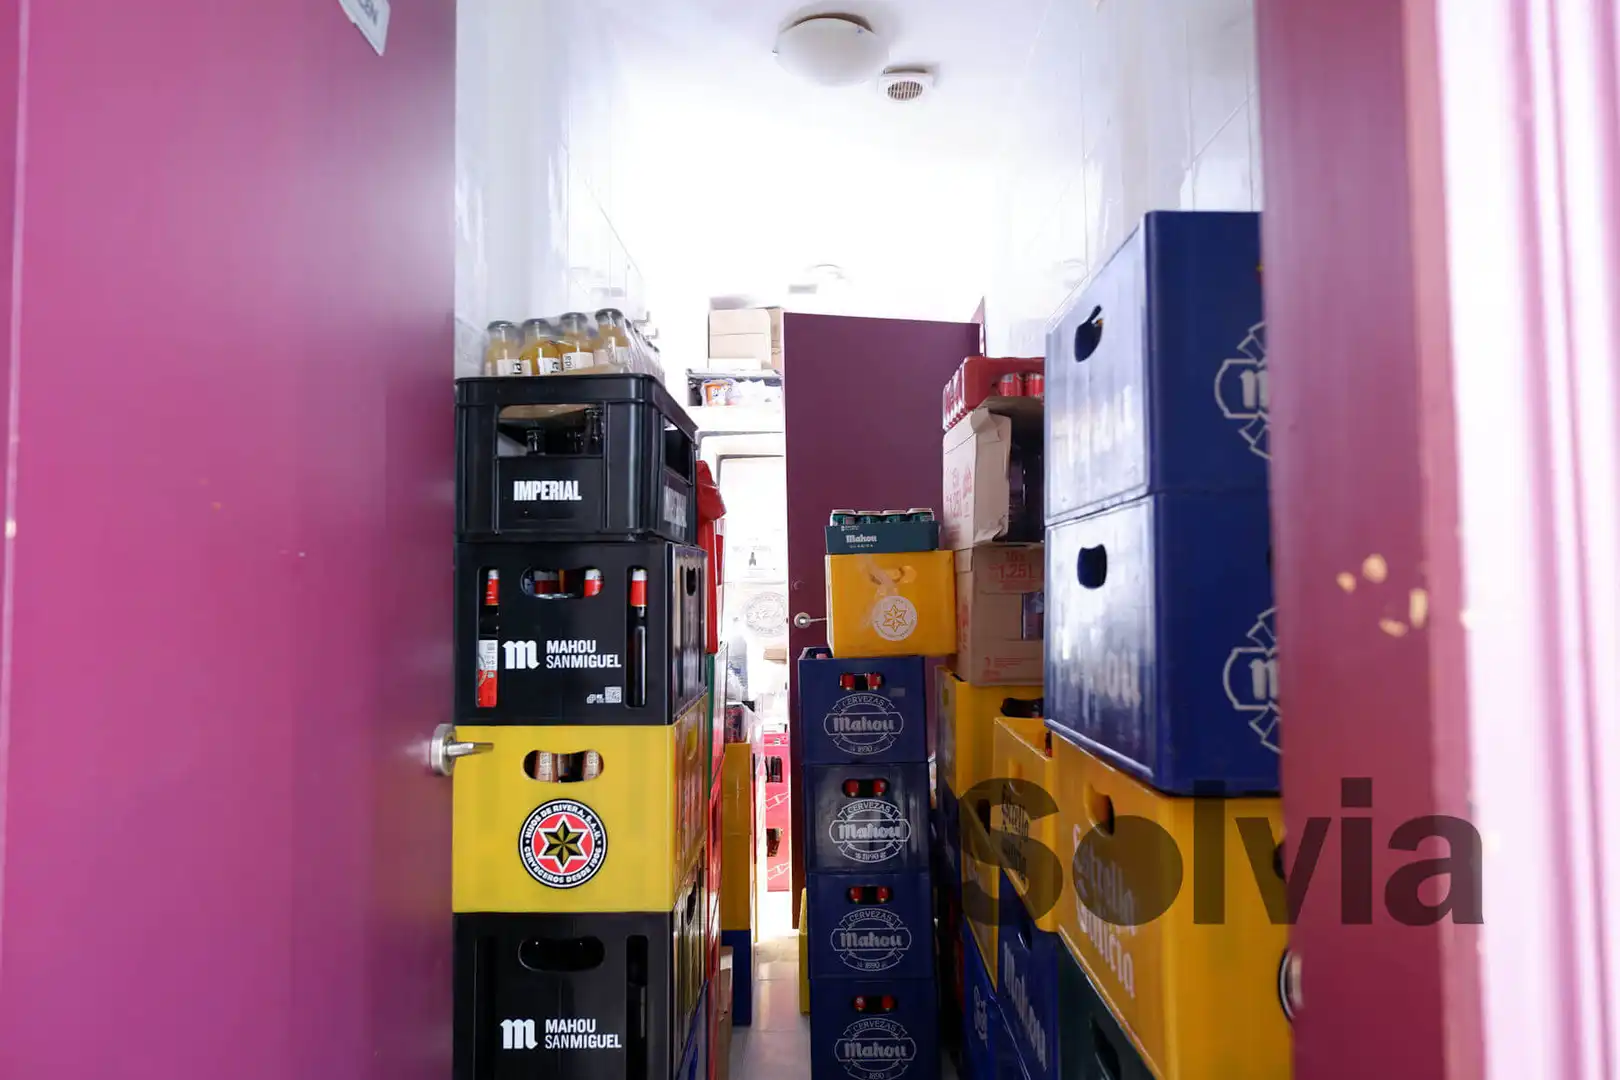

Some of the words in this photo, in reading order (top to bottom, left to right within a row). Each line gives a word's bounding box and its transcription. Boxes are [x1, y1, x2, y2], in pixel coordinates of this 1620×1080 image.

[513, 480, 582, 501] IMPERIAL
[845, 533, 878, 544] Mahou
[546, 640, 597, 654] MAHOU
[842, 696, 885, 707] CERVEZAS
[833, 716, 895, 732] Mahou
[540, 808, 553, 817] DE
[847, 801, 891, 813] CERVEZAS
[838, 823, 902, 840] Mahou
[524, 846, 564, 884] CERVECEROS
[566, 866, 591, 884] DESDE
[849, 910, 893, 922] CERVEZAS
[840, 931, 902, 948] Mahou
[545, 1018, 597, 1034] MAHOU
[853, 1020, 897, 1032] CERVEZAS
[844, 1041, 907, 1059] Mahou
